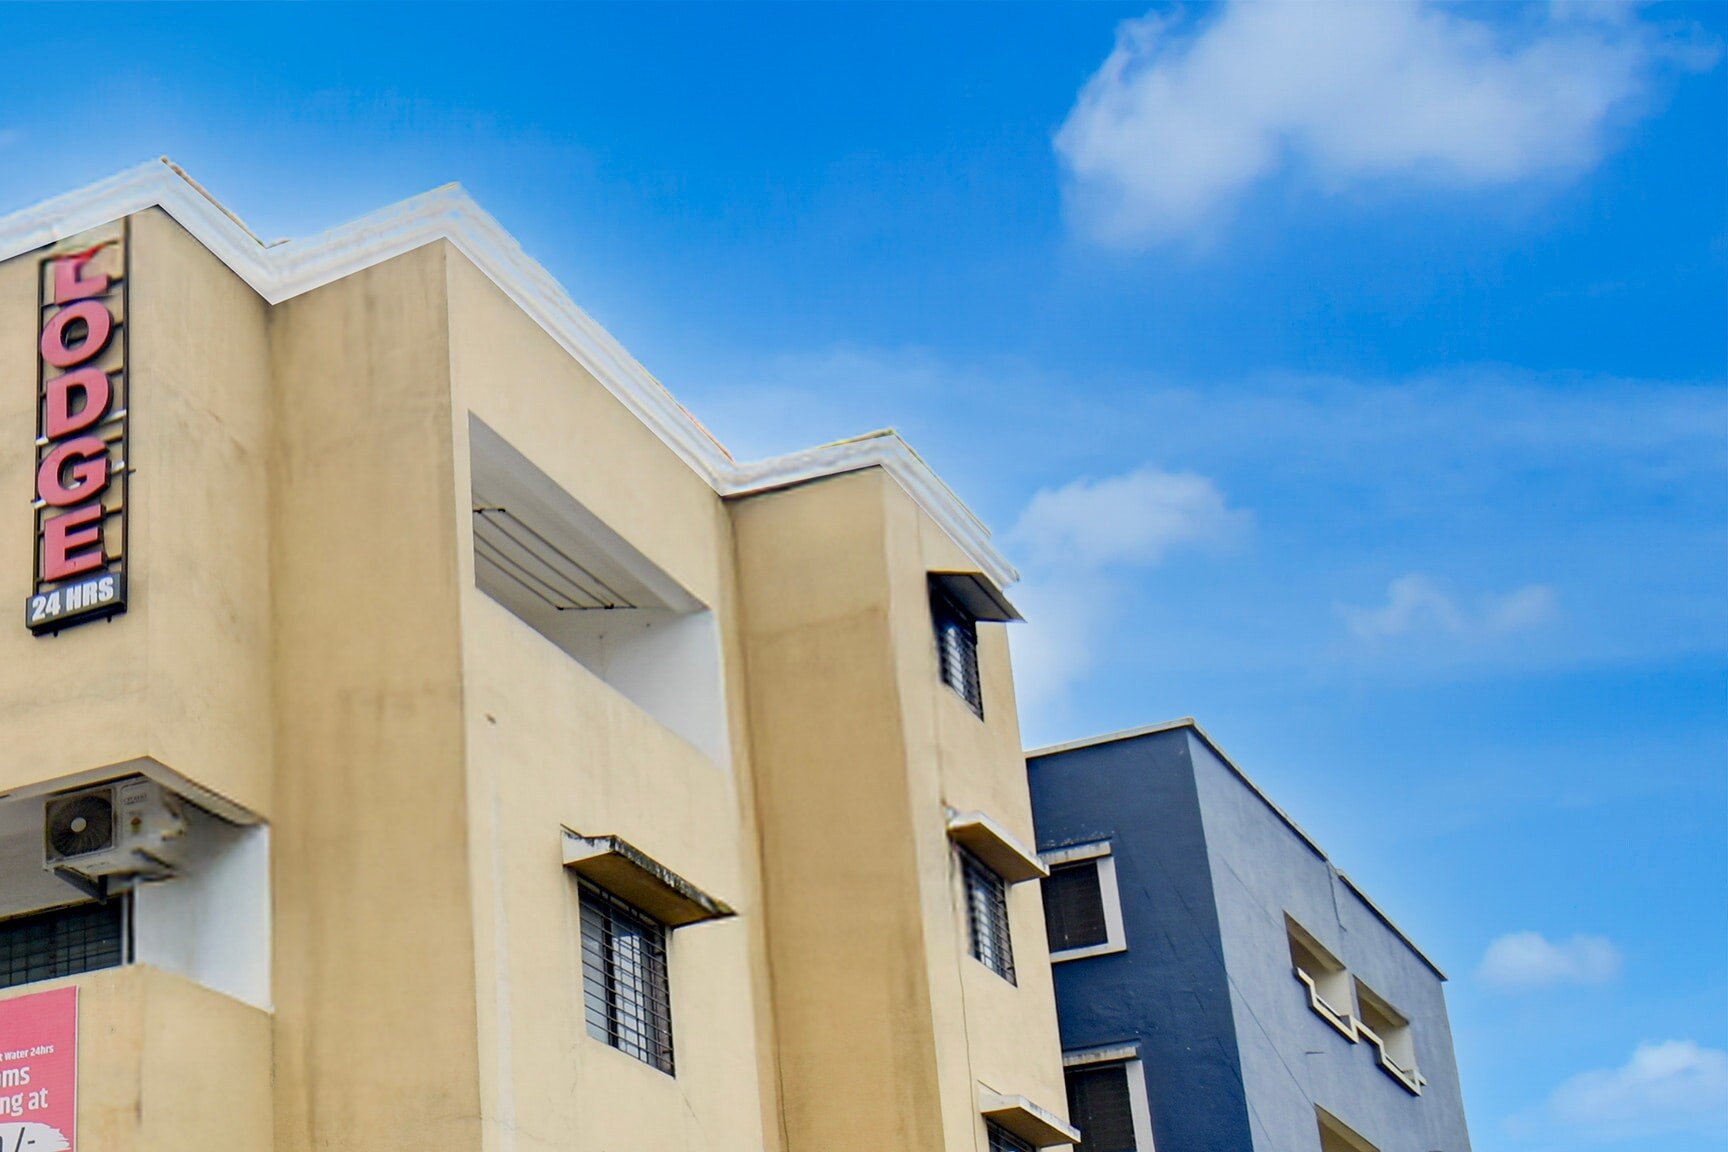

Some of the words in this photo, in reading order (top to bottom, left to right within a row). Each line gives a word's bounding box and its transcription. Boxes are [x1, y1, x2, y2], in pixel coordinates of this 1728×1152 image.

[38, 248, 113, 583] LODGE
[32, 590, 61, 622] 24
[65, 576, 114, 612] HRS
[4, 1048, 29, 1060] Water
[30, 1045, 54, 1057] 24hrs
[28, 1087, 49, 1111] at
